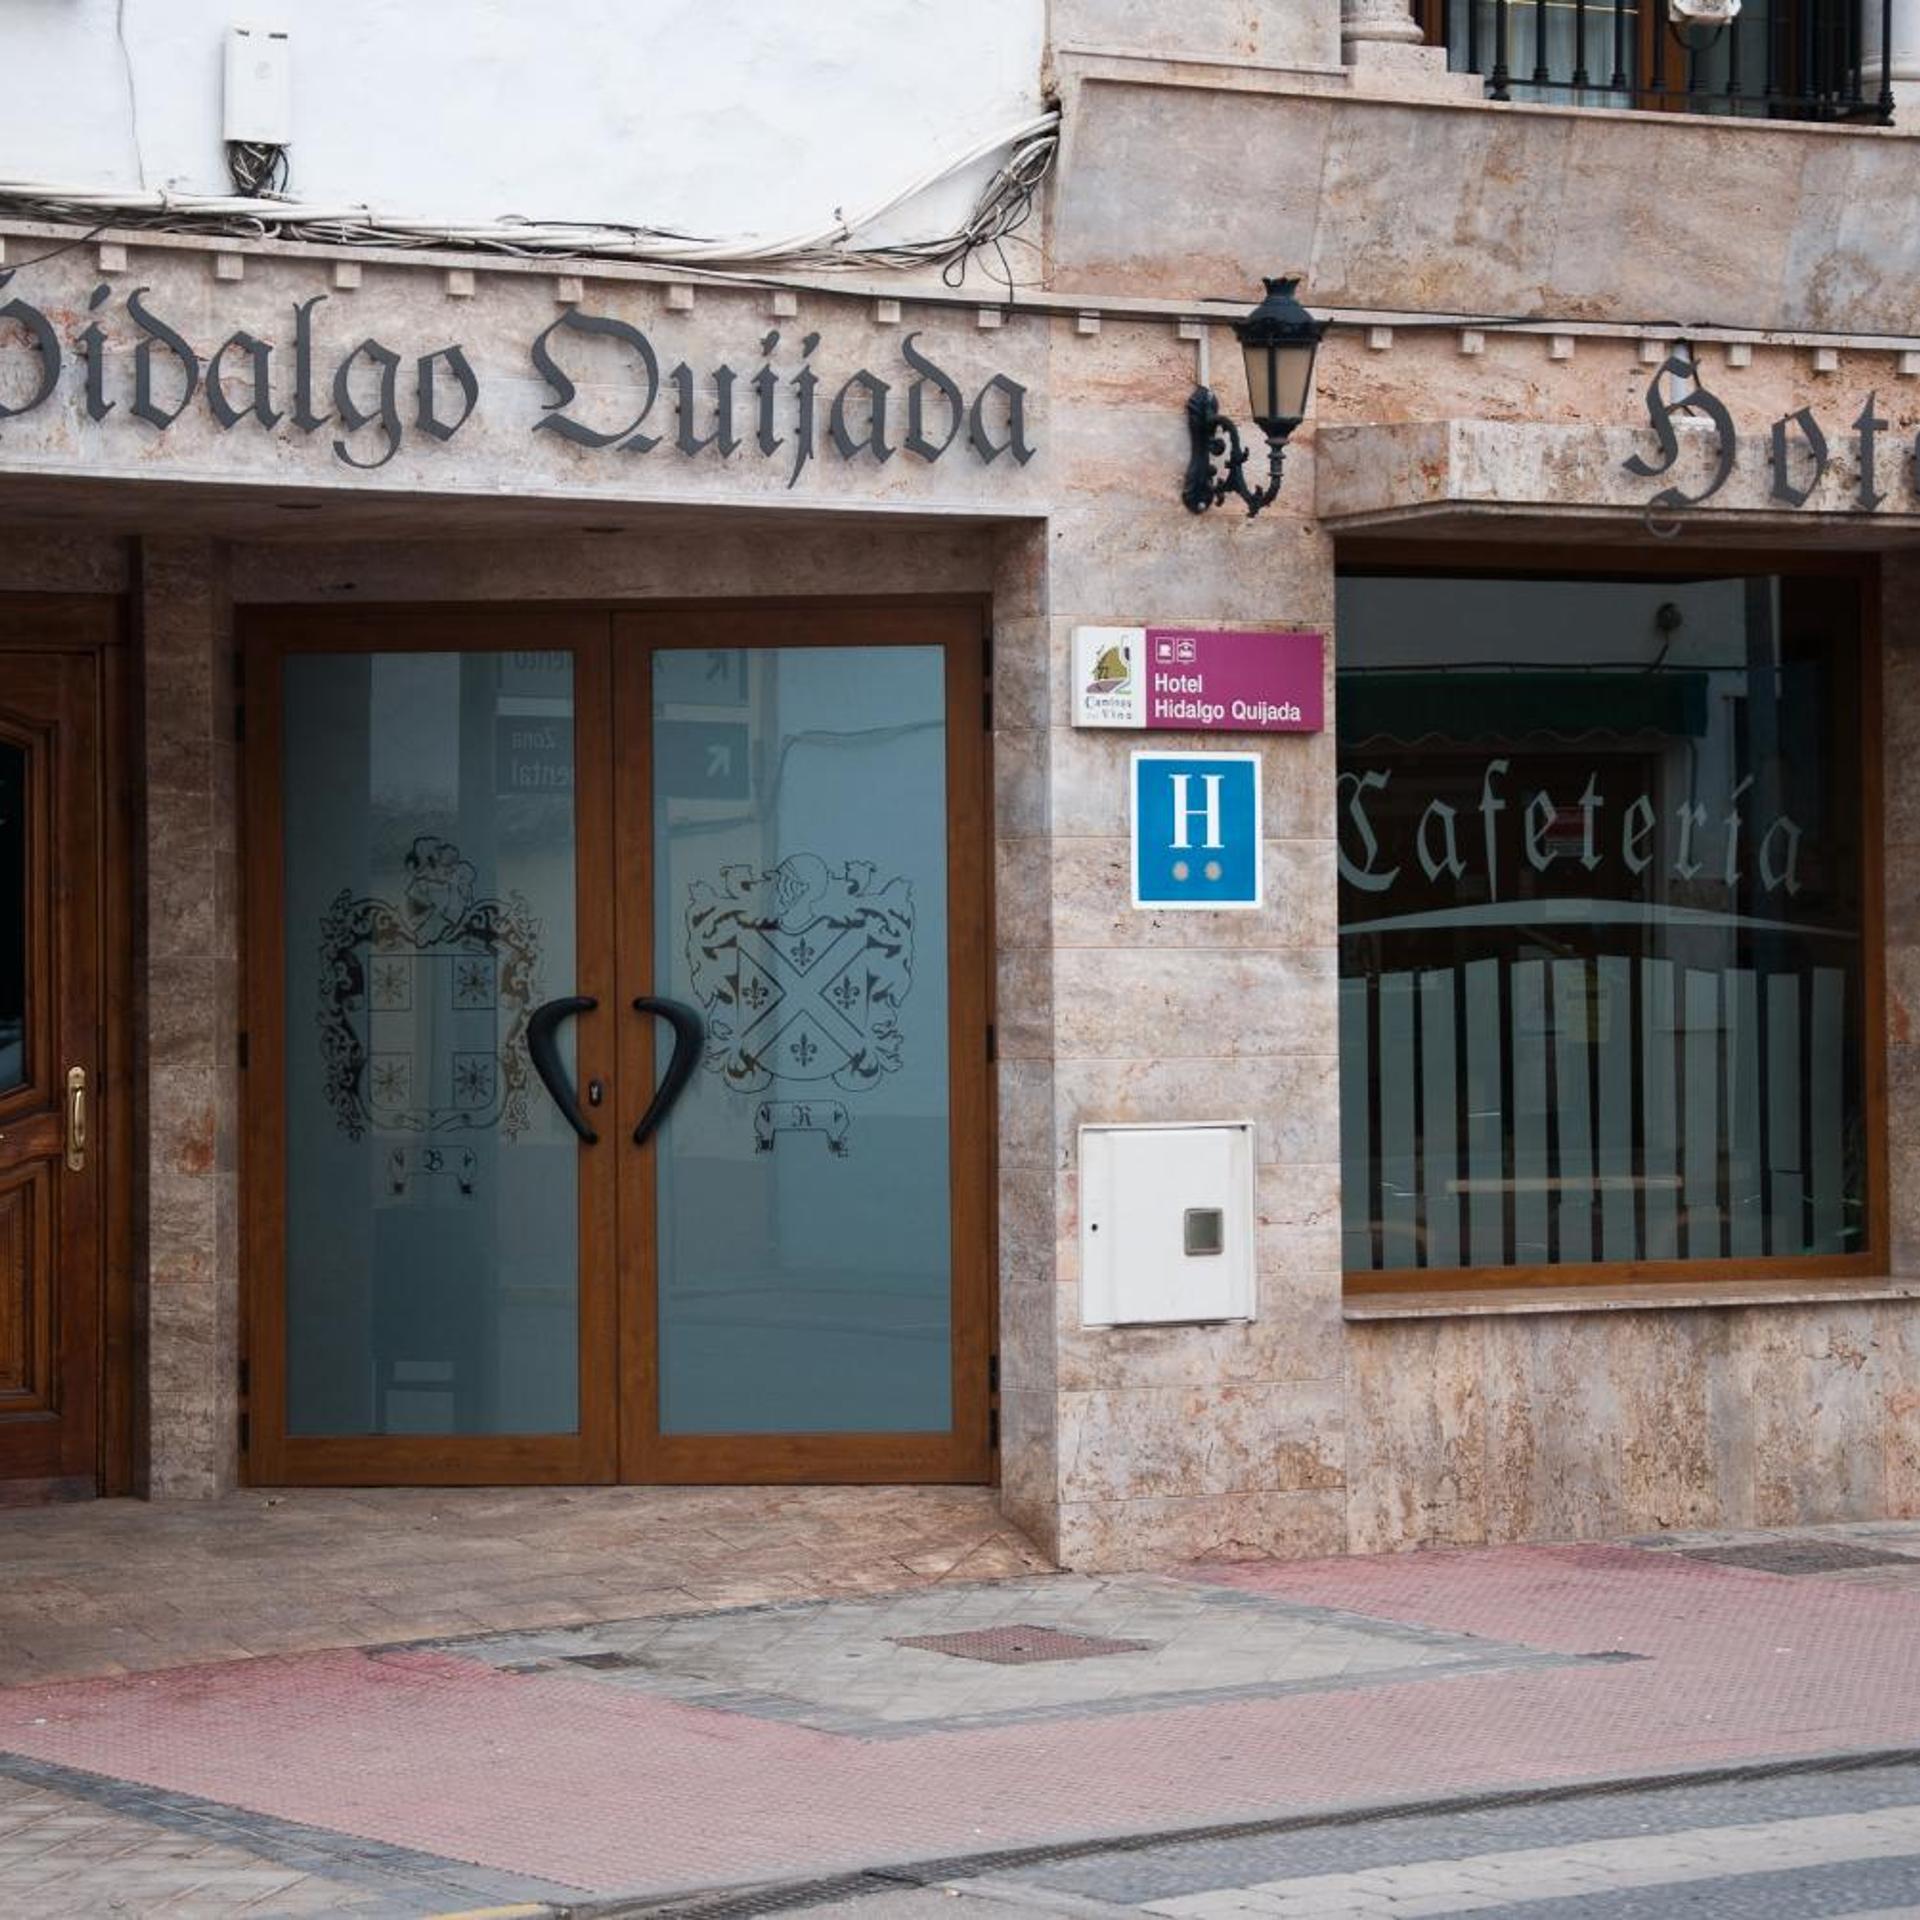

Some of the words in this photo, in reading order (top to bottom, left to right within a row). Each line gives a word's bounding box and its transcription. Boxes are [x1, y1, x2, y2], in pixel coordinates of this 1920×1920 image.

[530, 306, 1037, 489] Quijada
[1621, 355, 1920, 538] Hot
[1154, 673, 1203, 694] Hotel
[1154, 698, 1225, 724] Hidalgo
[1230, 699, 1302, 726] Quijada
[1167, 772, 1226, 850] H
[1337, 757, 1805, 904] Cafetería
